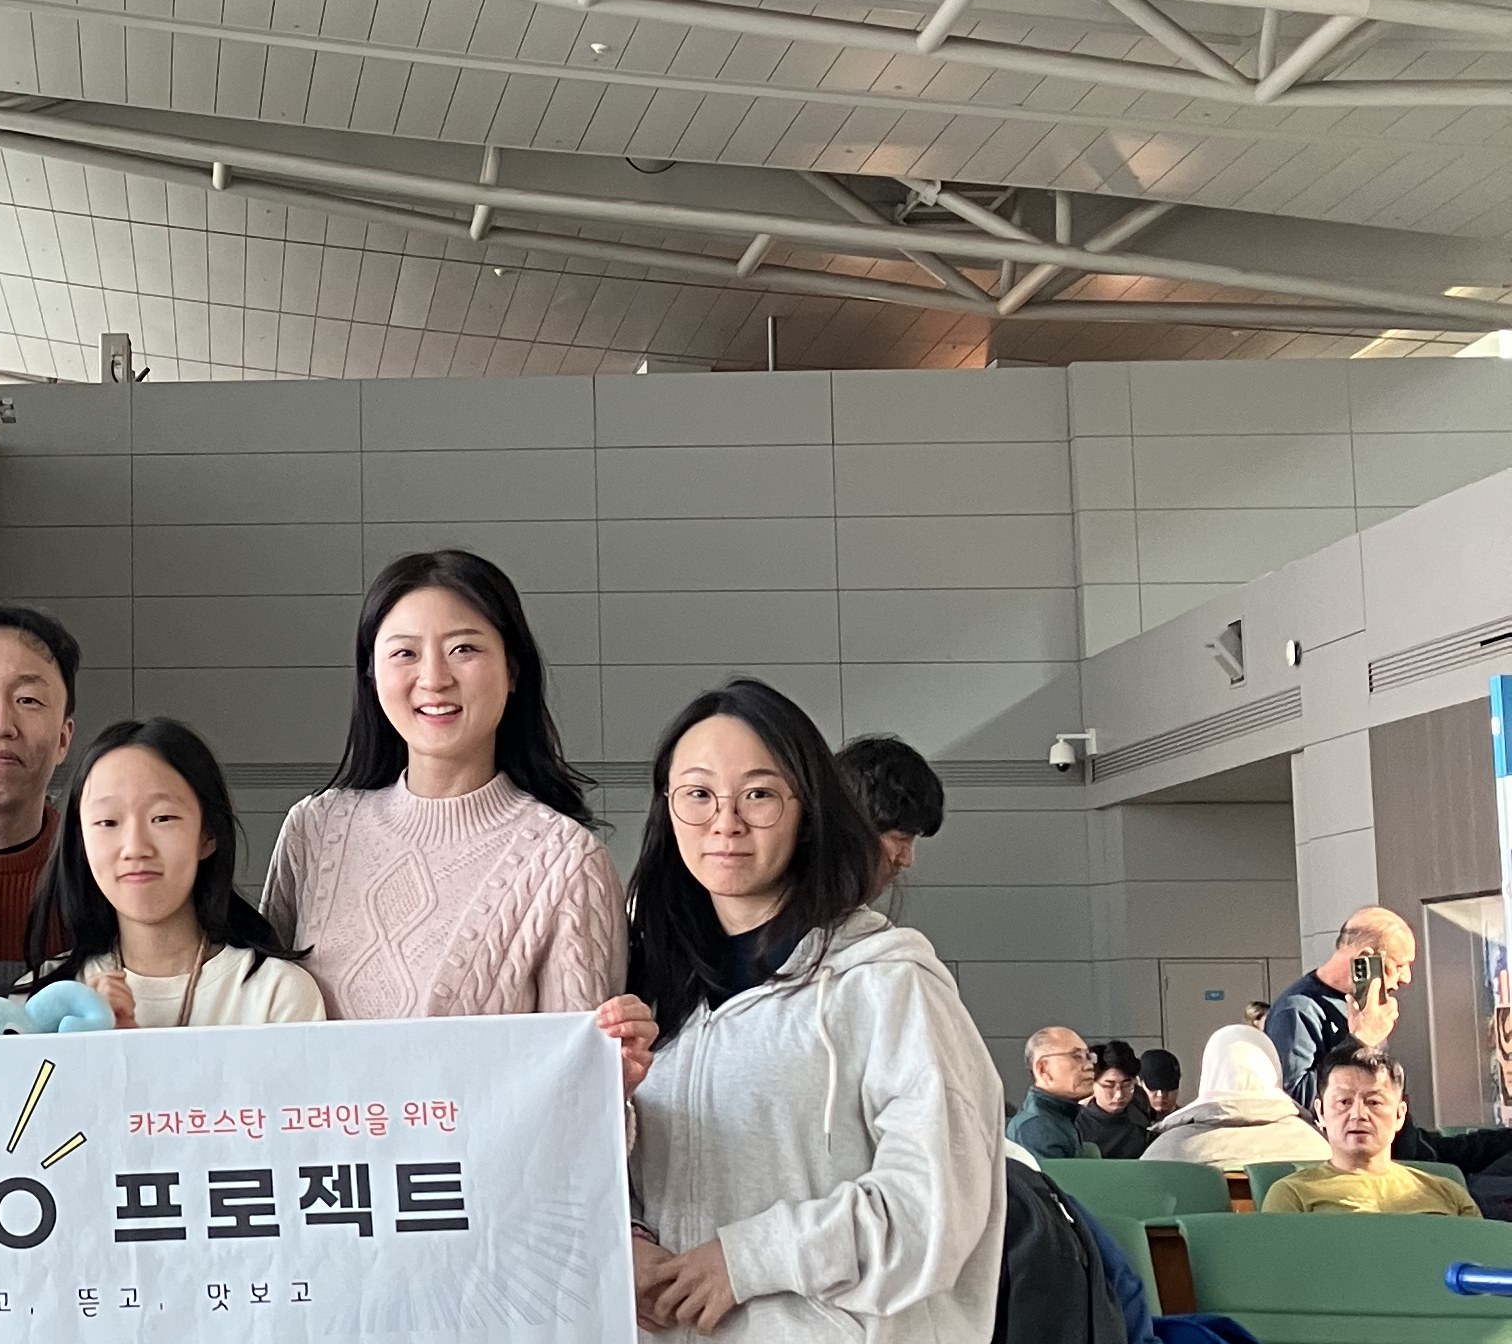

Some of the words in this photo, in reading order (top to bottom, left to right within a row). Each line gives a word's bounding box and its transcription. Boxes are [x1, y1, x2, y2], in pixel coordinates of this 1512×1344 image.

[129, 1108, 267, 1139] 카자흐스탄
[281, 1103, 389, 1136] 고려인을
[403, 1100, 459, 1132] 위한
[114, 1161, 470, 1243] 프로젝트
[207, 1281, 312, 1312] 맛보고
